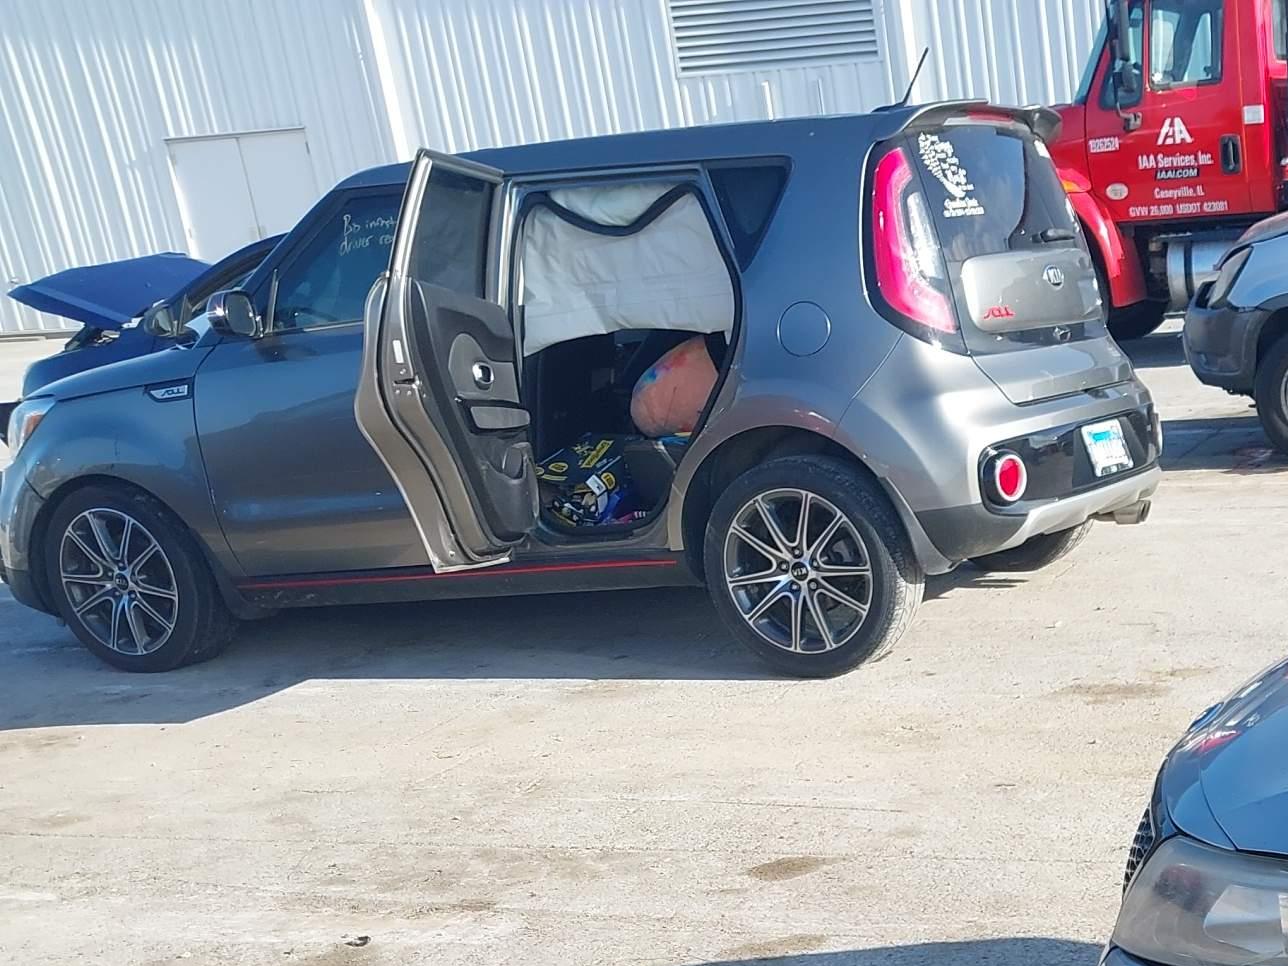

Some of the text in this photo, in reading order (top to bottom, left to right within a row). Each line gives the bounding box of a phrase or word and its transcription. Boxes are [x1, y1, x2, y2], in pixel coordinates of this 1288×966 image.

[1138, 150, 1214, 170] IAA Services, Inc.
